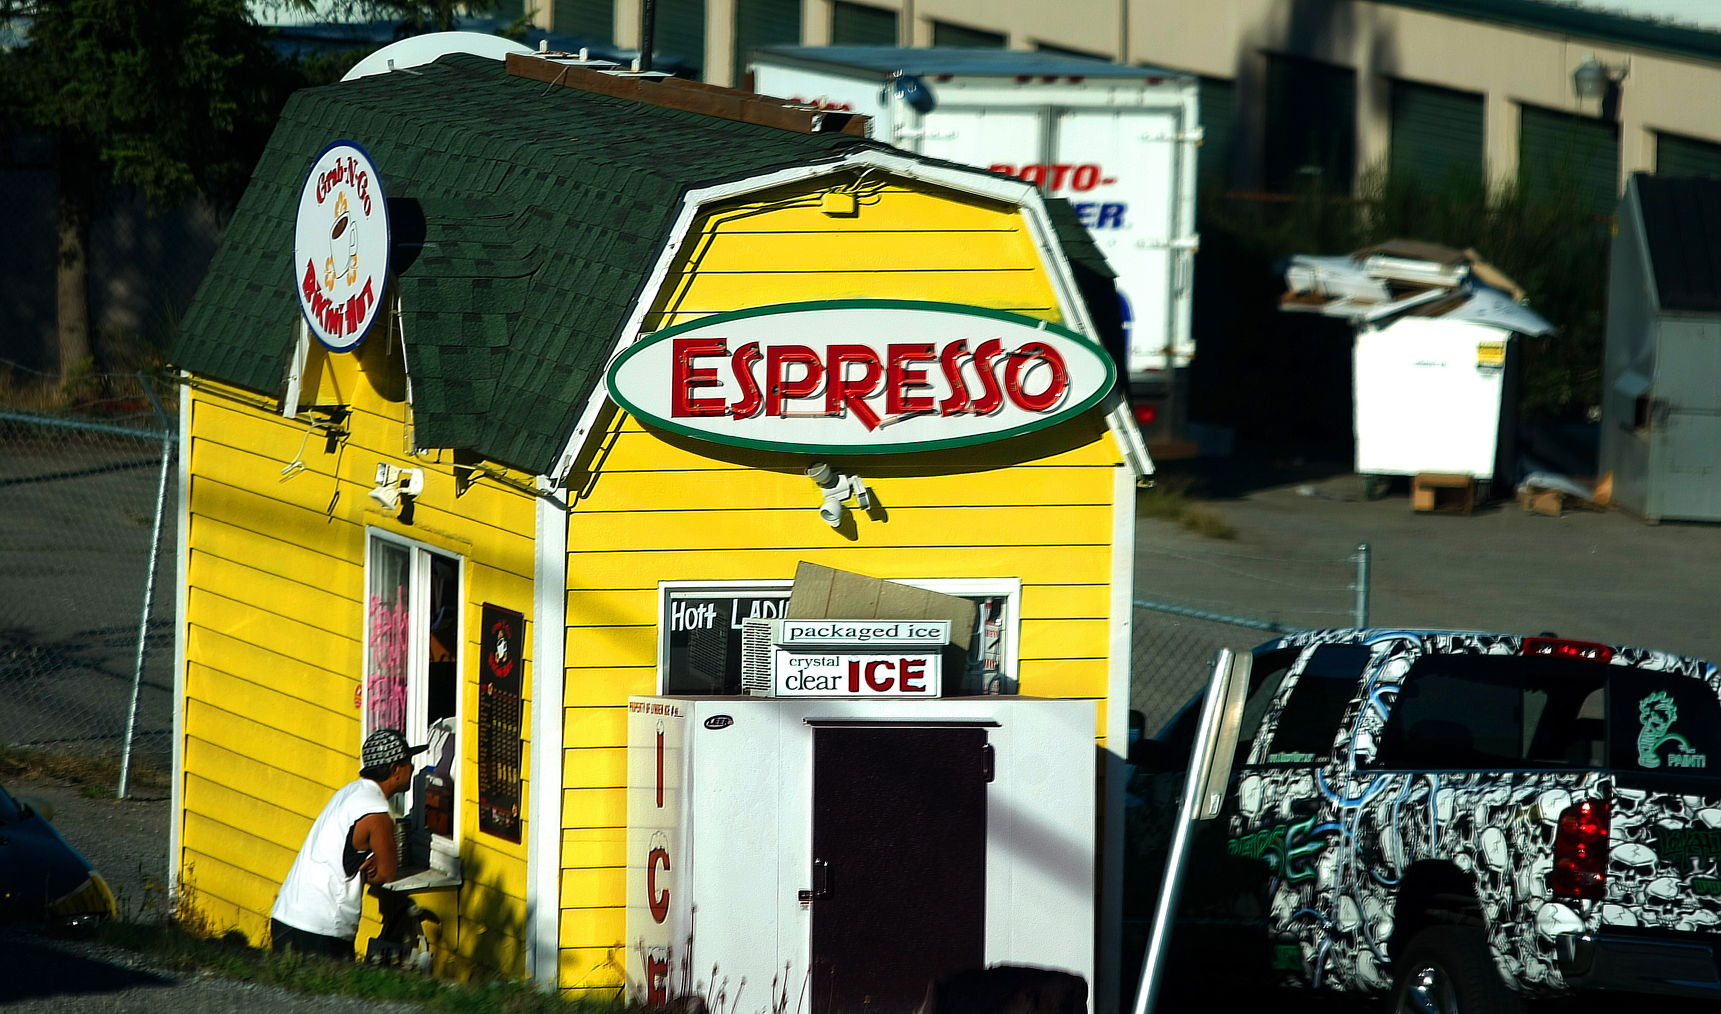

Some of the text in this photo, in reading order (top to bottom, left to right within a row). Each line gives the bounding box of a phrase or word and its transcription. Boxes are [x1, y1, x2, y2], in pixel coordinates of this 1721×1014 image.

[671, 337, 1072, 432] ESPRESSO
[671, 600, 718, 632] Hott
[790, 624, 941, 641] packaged ice
[785, 655, 927, 692] clear ICE
[789, 655, 840, 668] crystal
